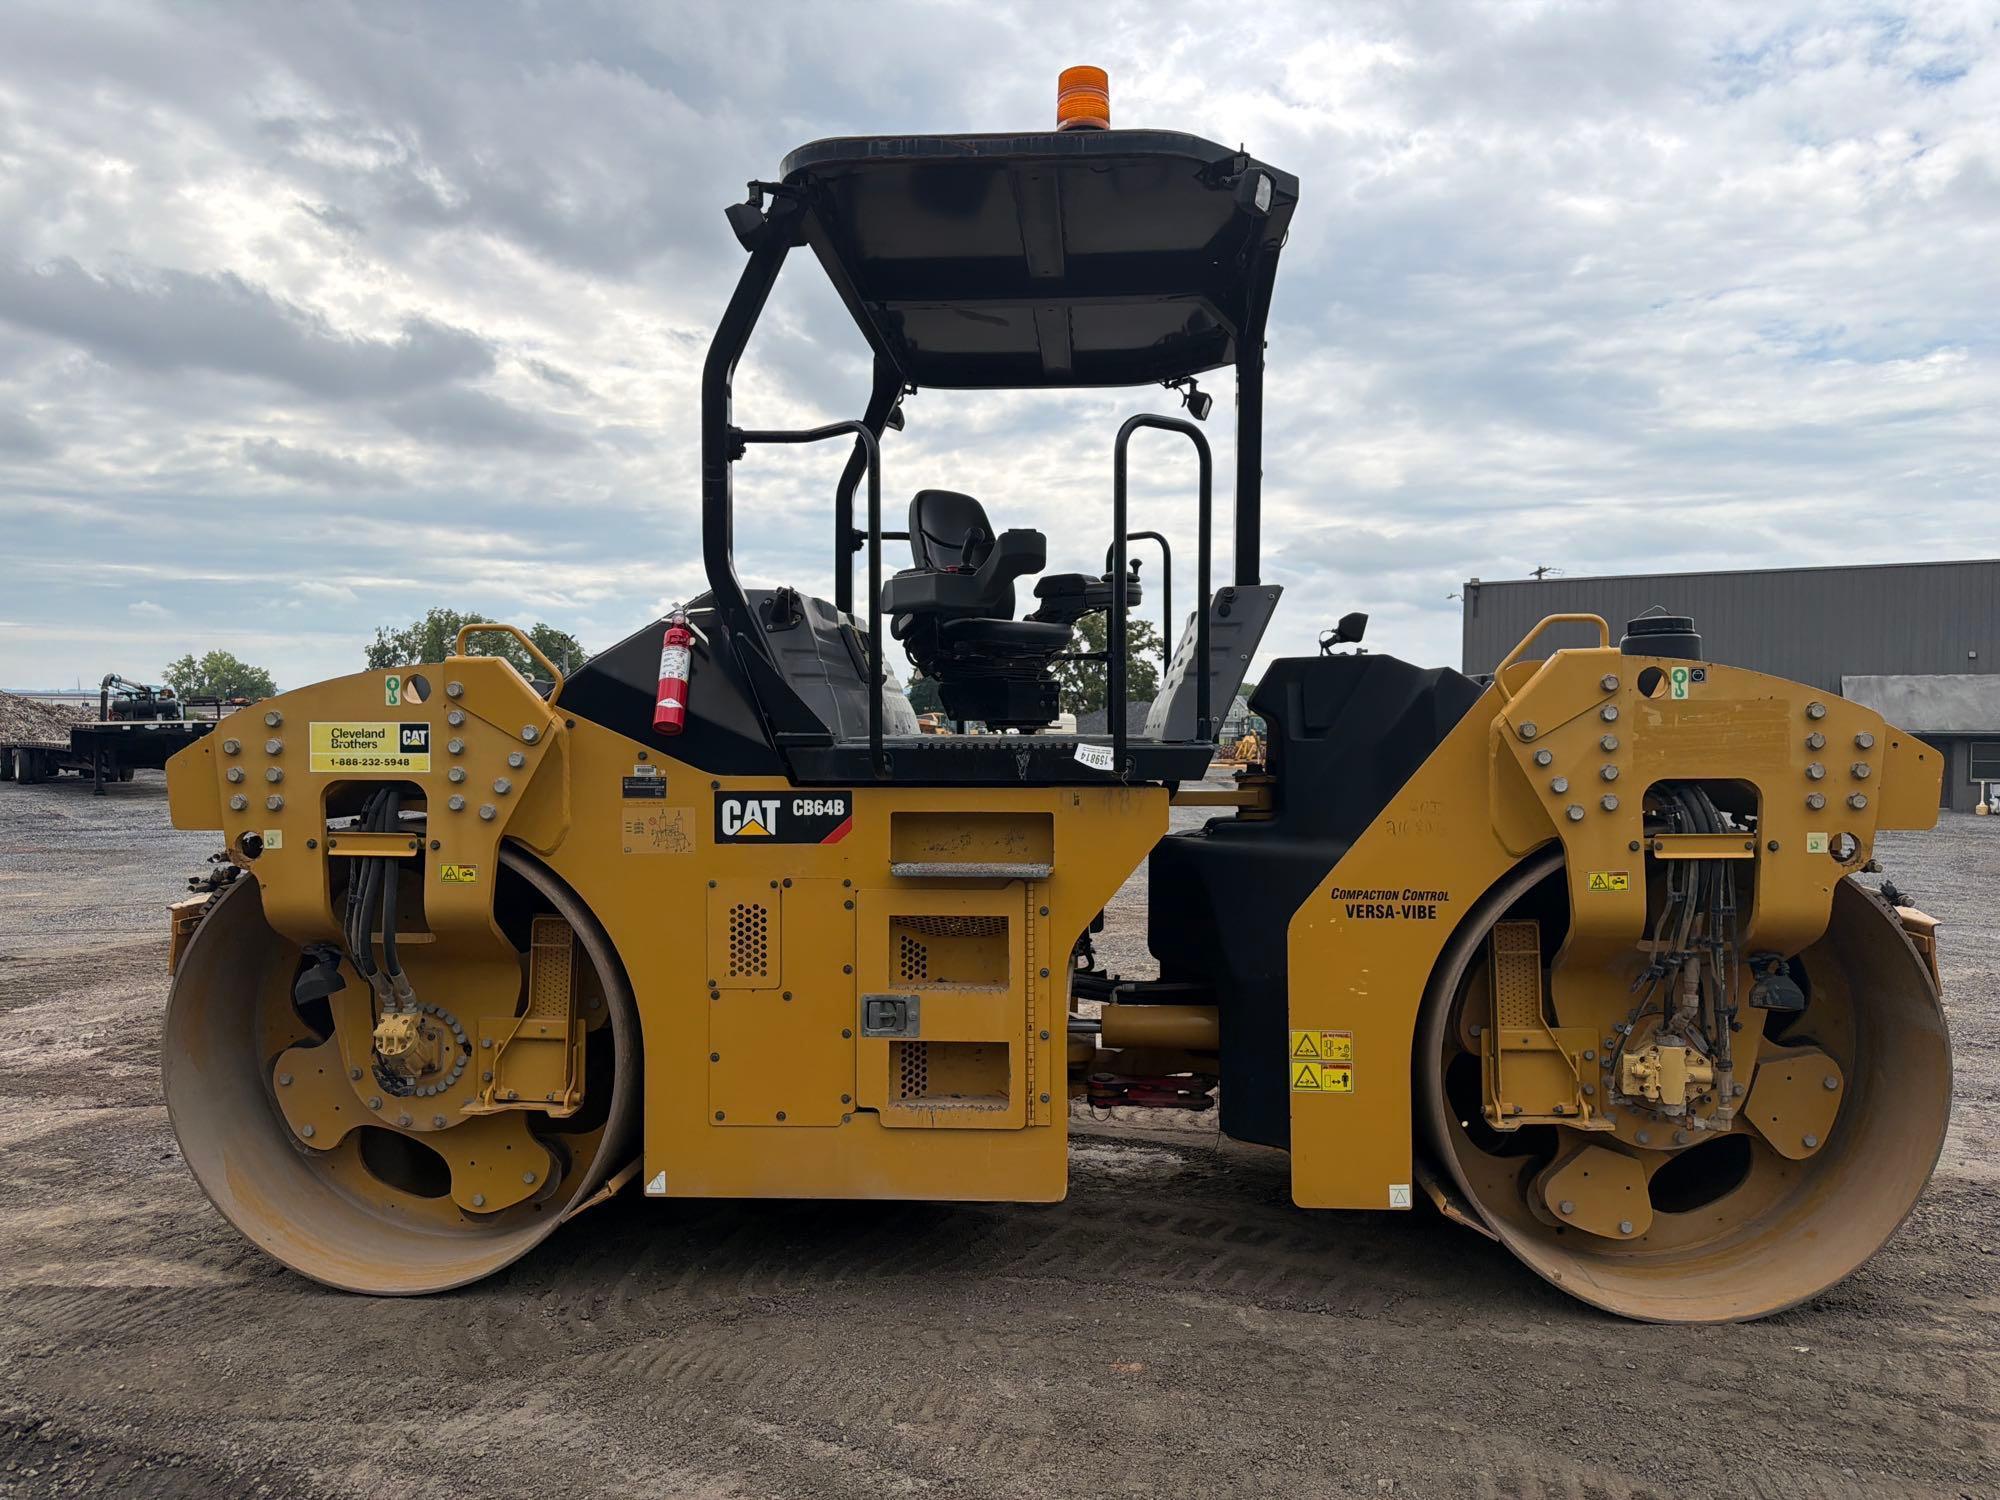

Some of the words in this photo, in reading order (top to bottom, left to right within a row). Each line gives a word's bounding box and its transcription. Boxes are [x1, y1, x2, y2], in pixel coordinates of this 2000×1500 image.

[331, 728, 385, 739] Cleveland
[402, 729, 427, 746] CAT
[331, 739, 378, 749] Brothers
[330, 758, 410, 766] 1-888-232-5948
[722, 799, 781, 836] CAT
[792, 799, 845, 816] CB64B
[1331, 887, 1399, 901] COMPACTION
[1402, 888, 1450, 902] CONTROL
[1345, 904, 1437, 920] VERSA-VIBE
